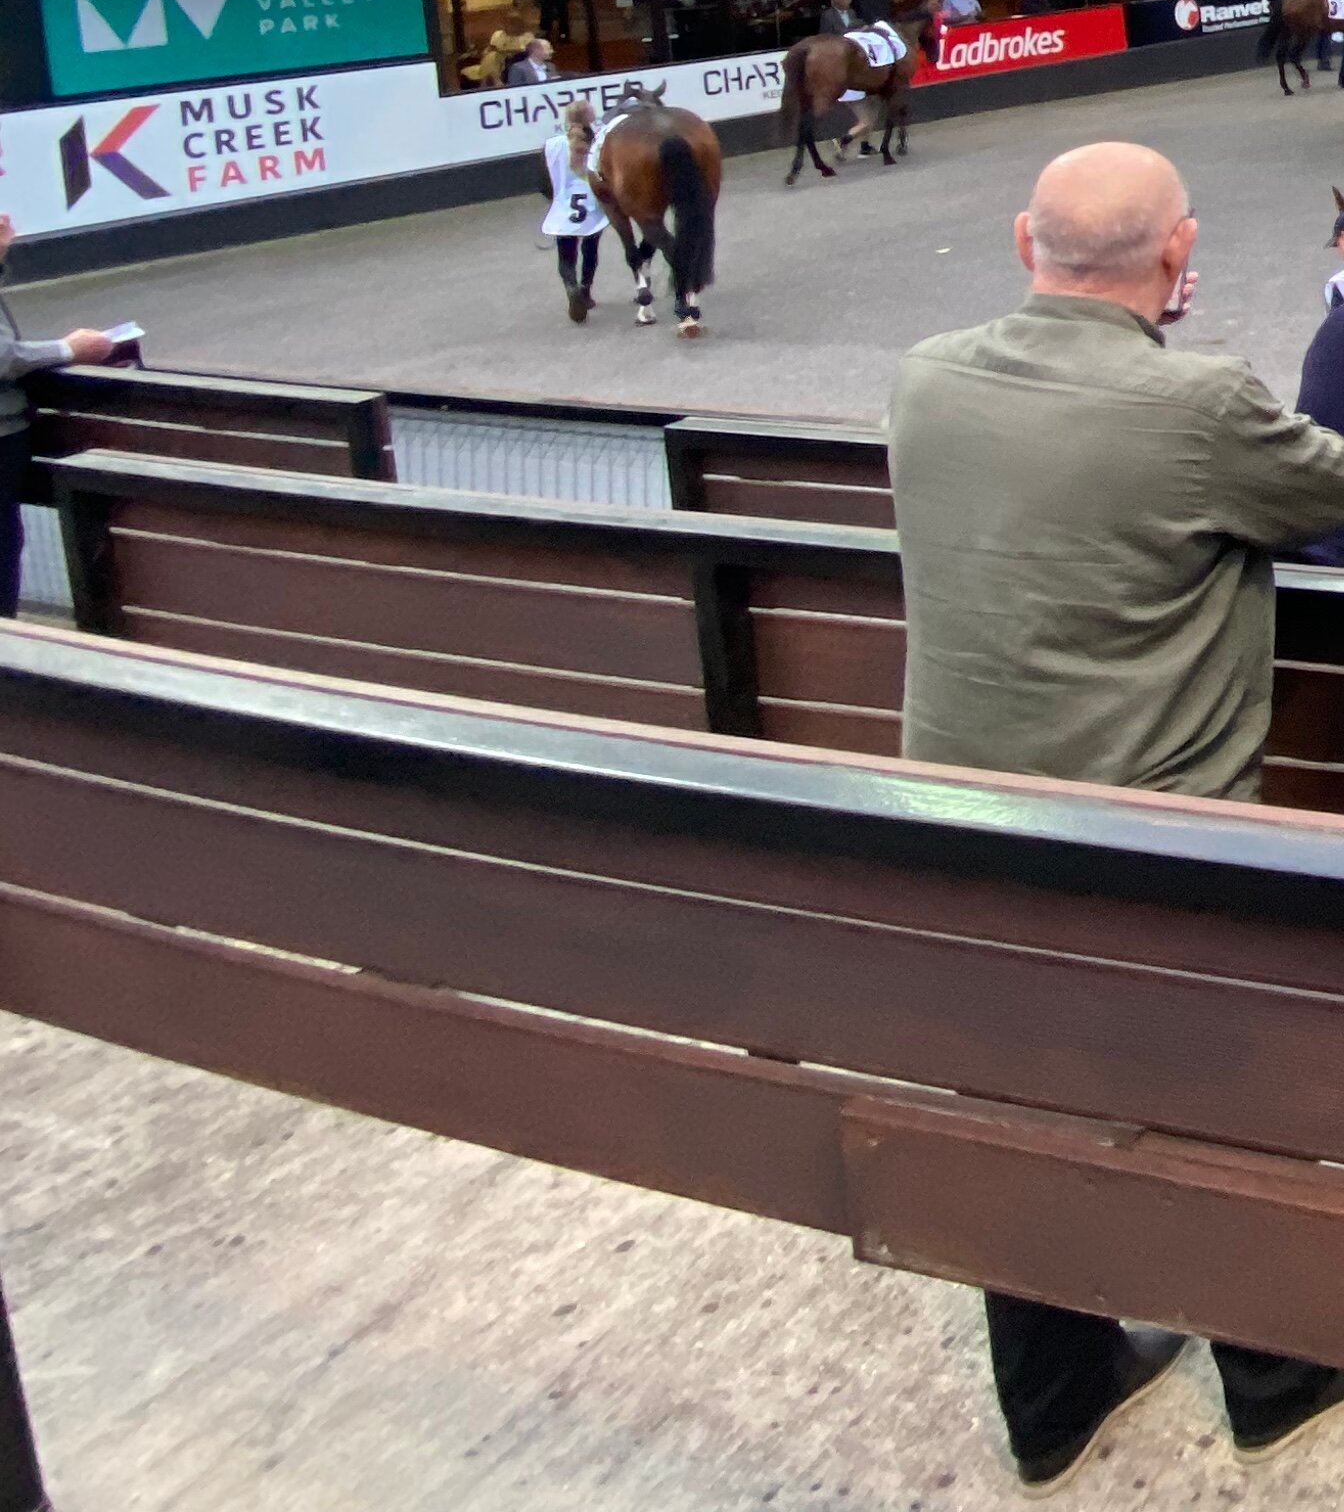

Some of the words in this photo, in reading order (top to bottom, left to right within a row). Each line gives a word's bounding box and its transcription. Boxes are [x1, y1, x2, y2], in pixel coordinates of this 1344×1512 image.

[259, 14, 340, 35] PARK
[936, 26, 1065, 71] Ladbrokes
[703, 62, 781, 96] CHAR
[179, 85, 320, 126] MUSK
[183, 116, 325, 159] CREEK
[186, 147, 327, 193] FARM
[569, 193, 588, 223] 5
